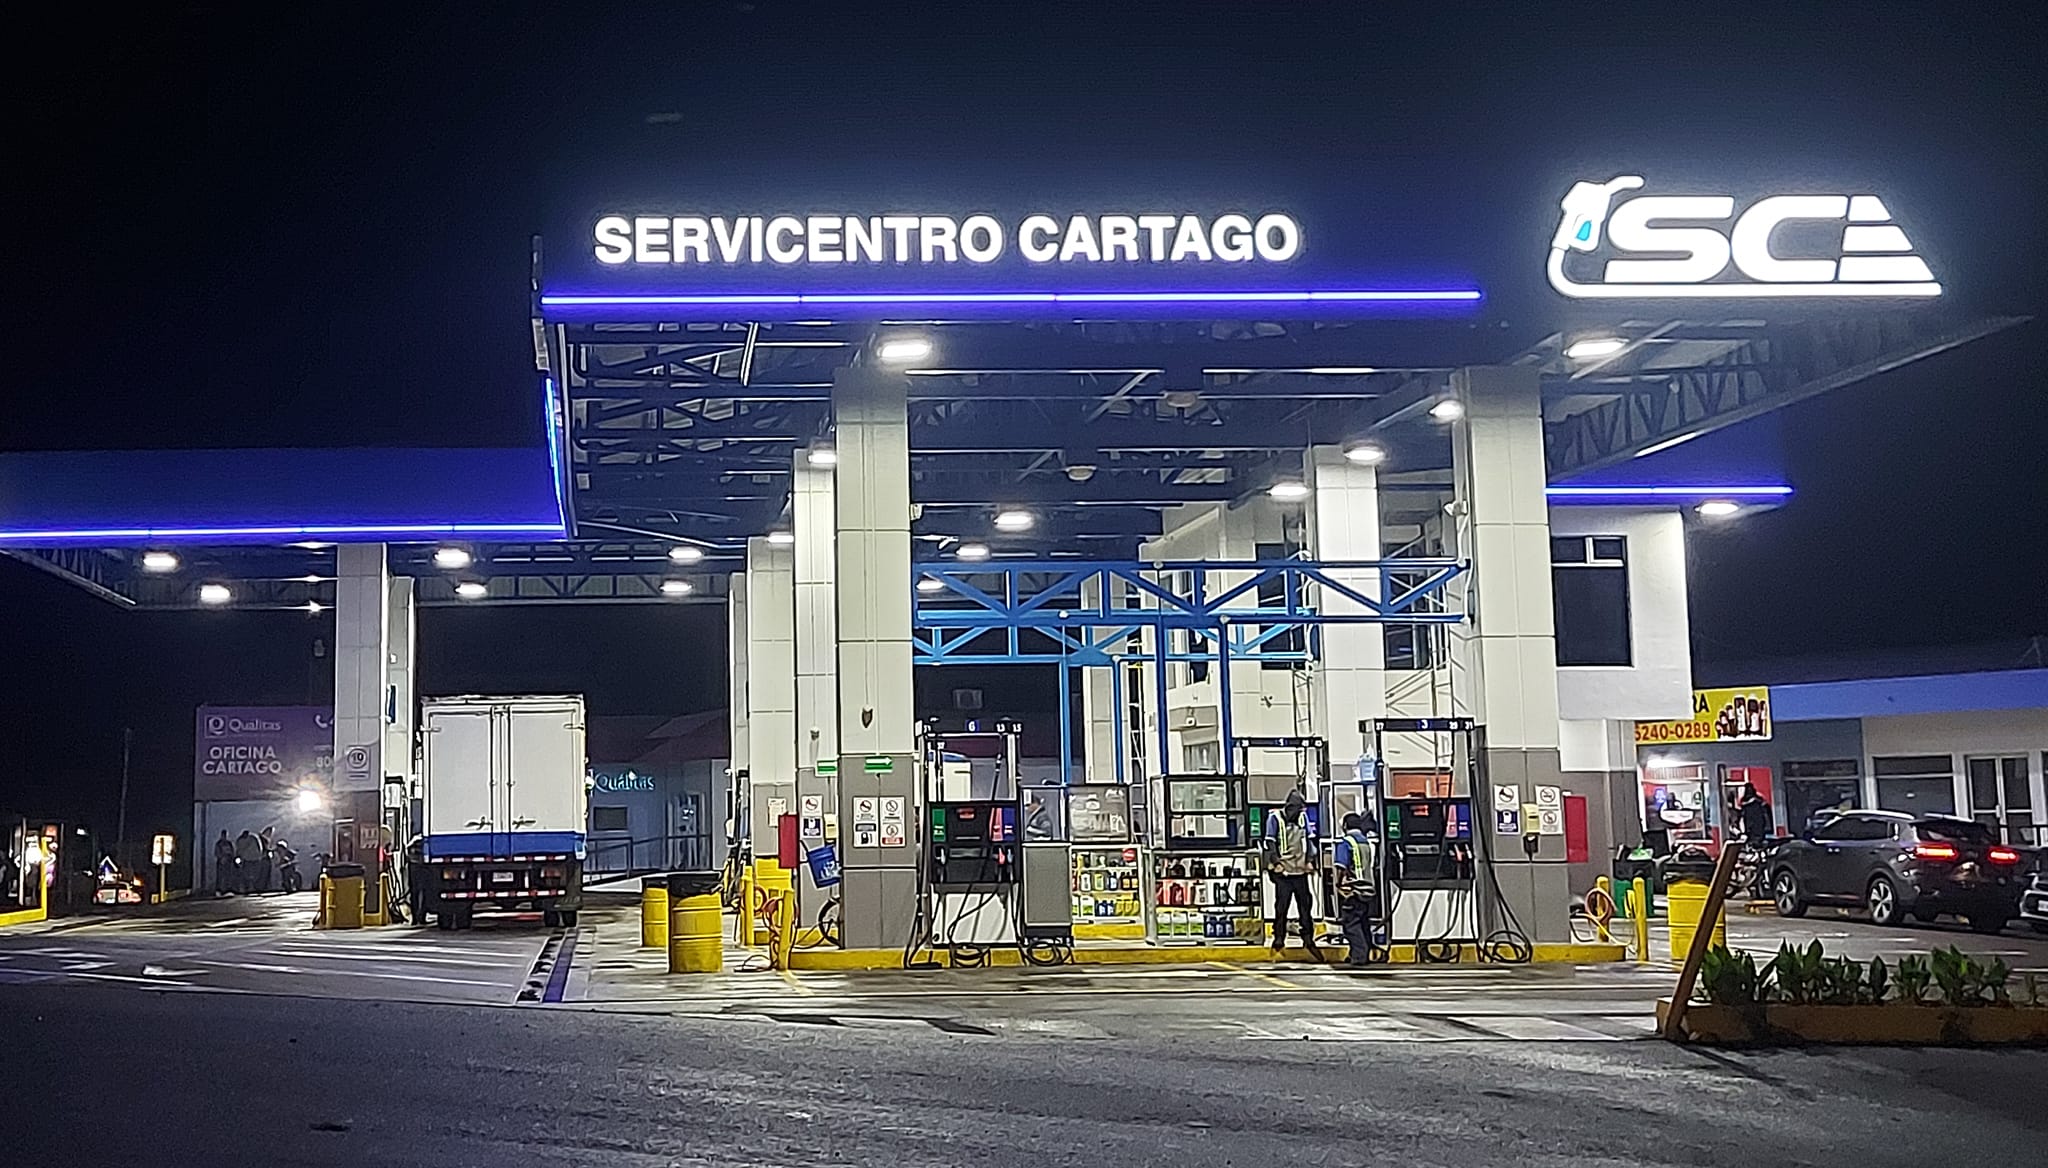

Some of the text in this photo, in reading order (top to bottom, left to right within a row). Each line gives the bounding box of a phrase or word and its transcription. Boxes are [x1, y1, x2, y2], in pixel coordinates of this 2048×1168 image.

[594, 213, 1299, 265] SERVICENTRO CARTAGO
[209, 746, 277, 760] OFICINA
[202, 761, 282, 774] CARTAGO
